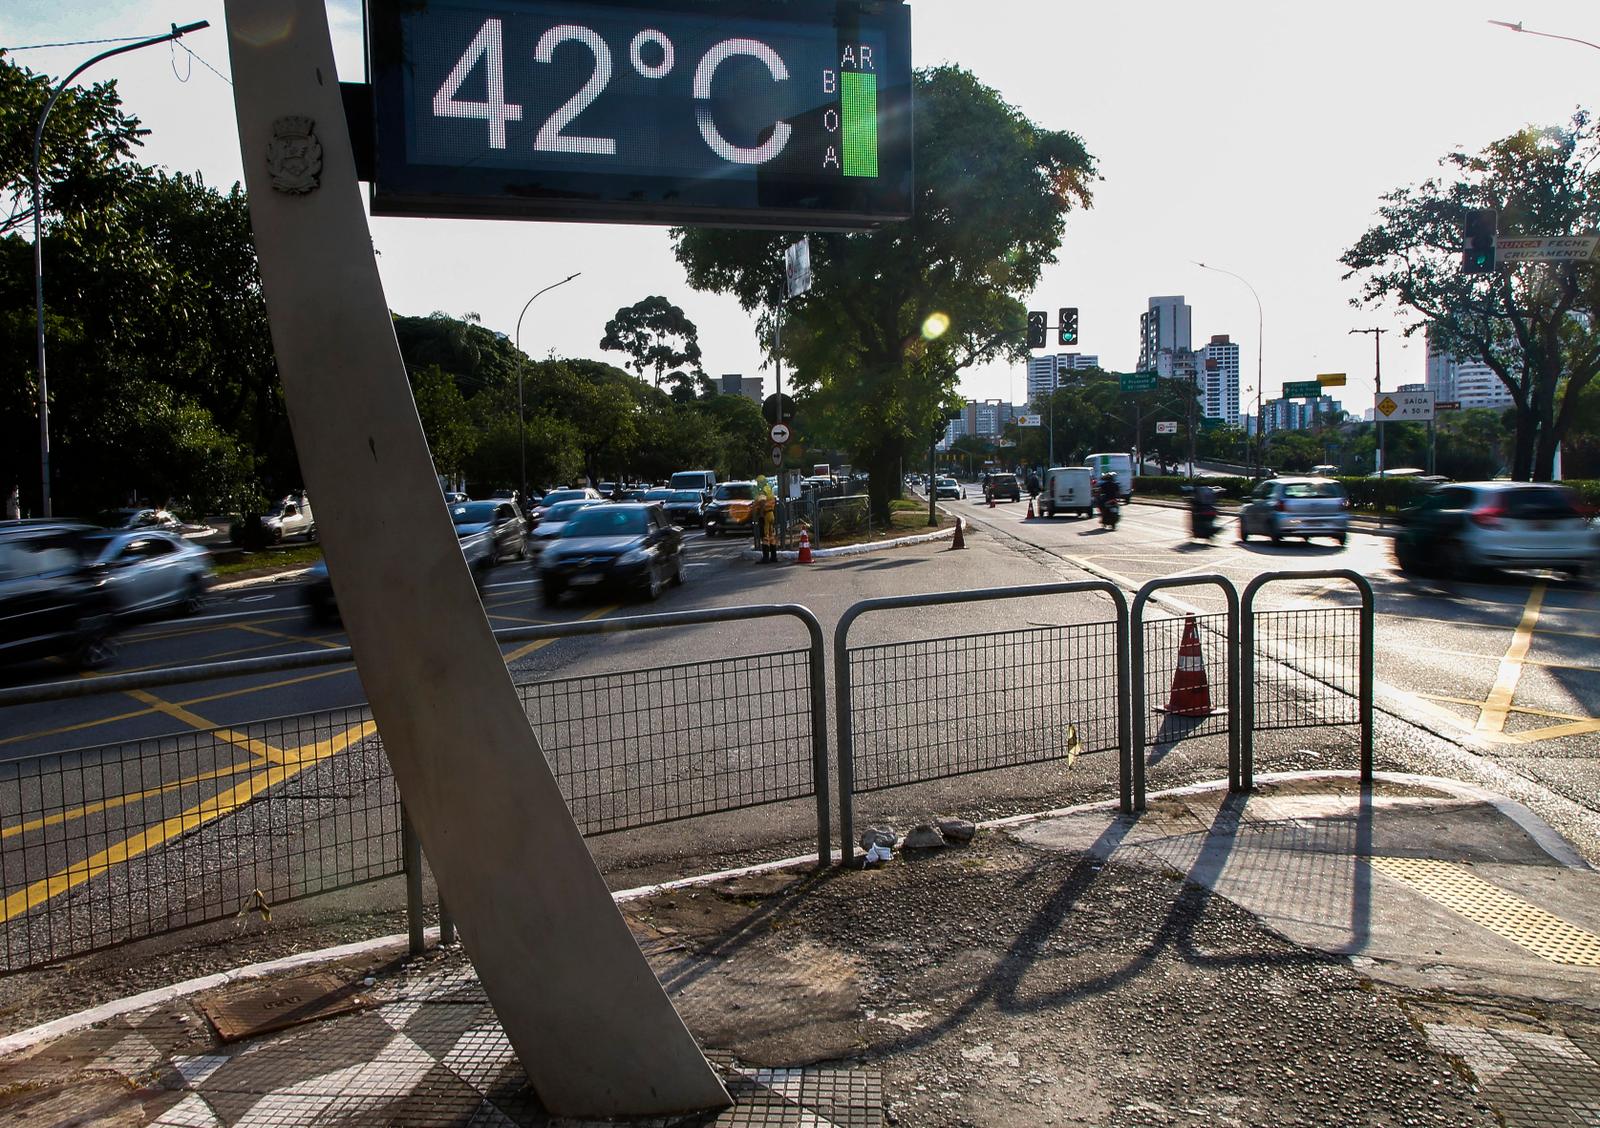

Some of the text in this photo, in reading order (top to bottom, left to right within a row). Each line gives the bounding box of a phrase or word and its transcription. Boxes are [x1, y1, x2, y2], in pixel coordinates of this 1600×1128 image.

[841, 45, 874, 69] AR
[433, 18, 791, 165] 42°C
[1497, 240, 1539, 249] NUNCA
[1504, 250, 1587, 259] CRUZAMENTO
